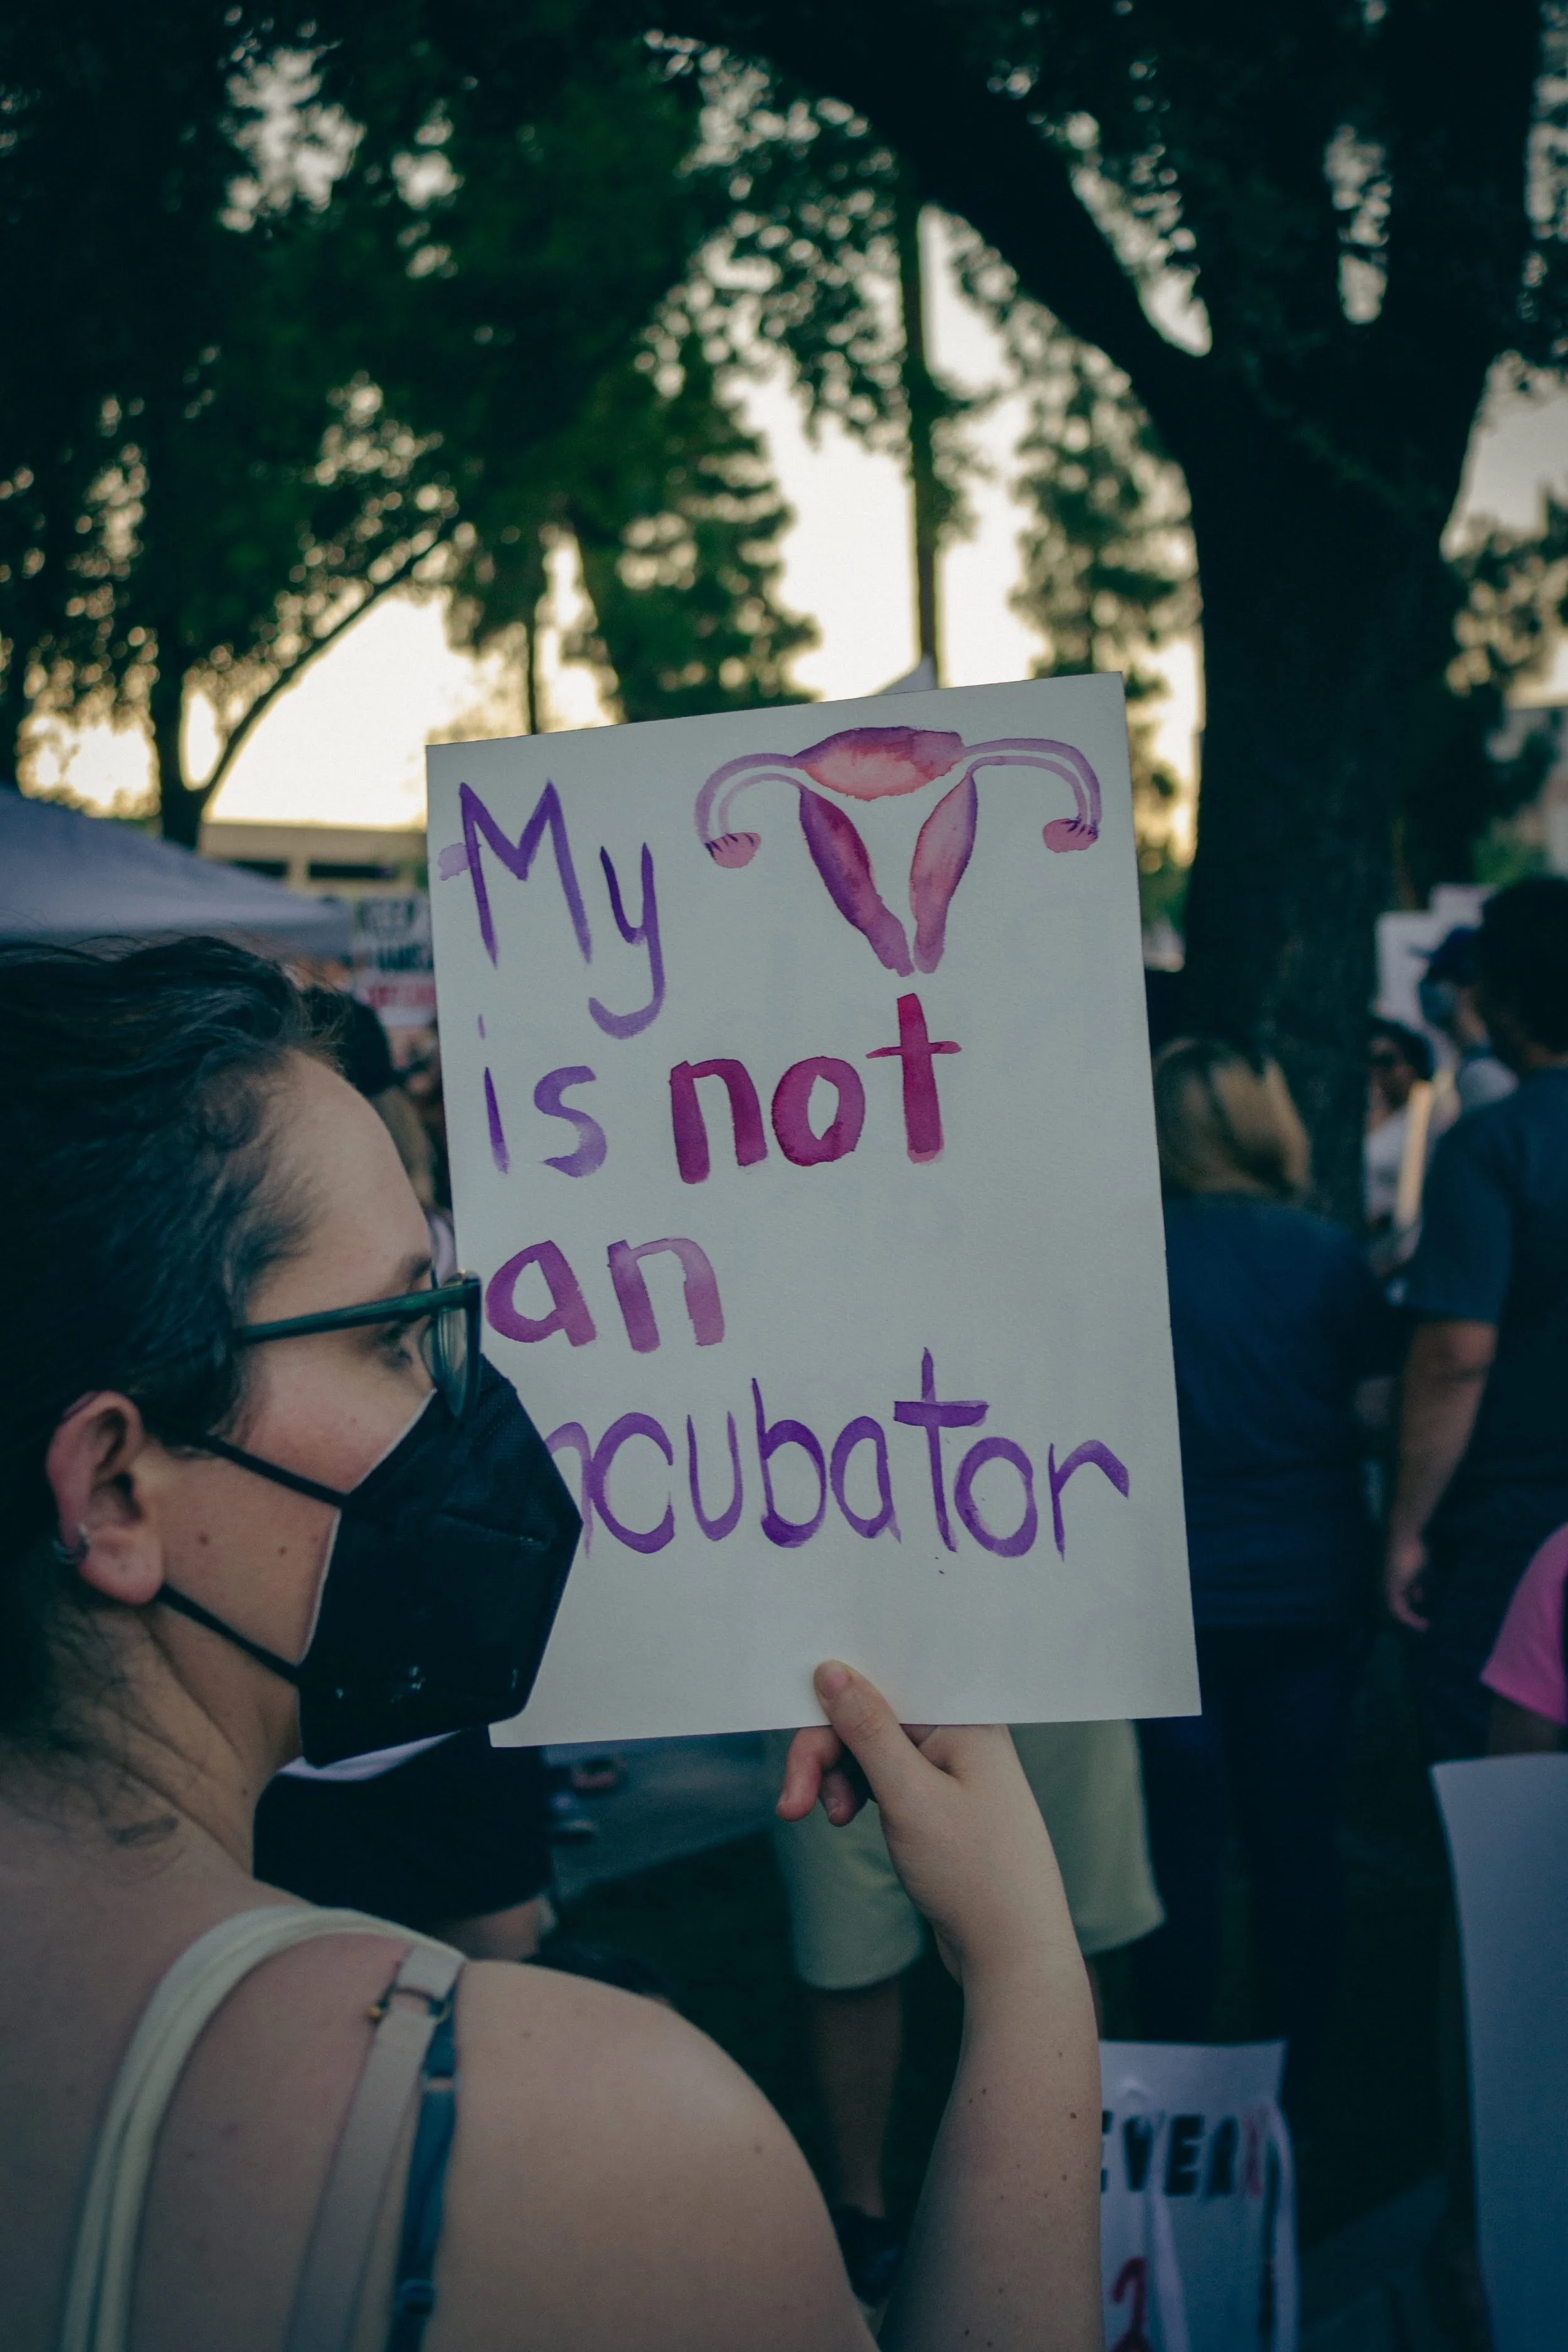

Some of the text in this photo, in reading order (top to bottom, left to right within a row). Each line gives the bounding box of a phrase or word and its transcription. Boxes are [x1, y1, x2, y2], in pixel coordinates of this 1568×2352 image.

[459, 781, 665, 1039] My
[478, 993, 961, 1185] is not
[485, 1237, 725, 1353] an
[544, 1348, 1130, 1560] ncubator
